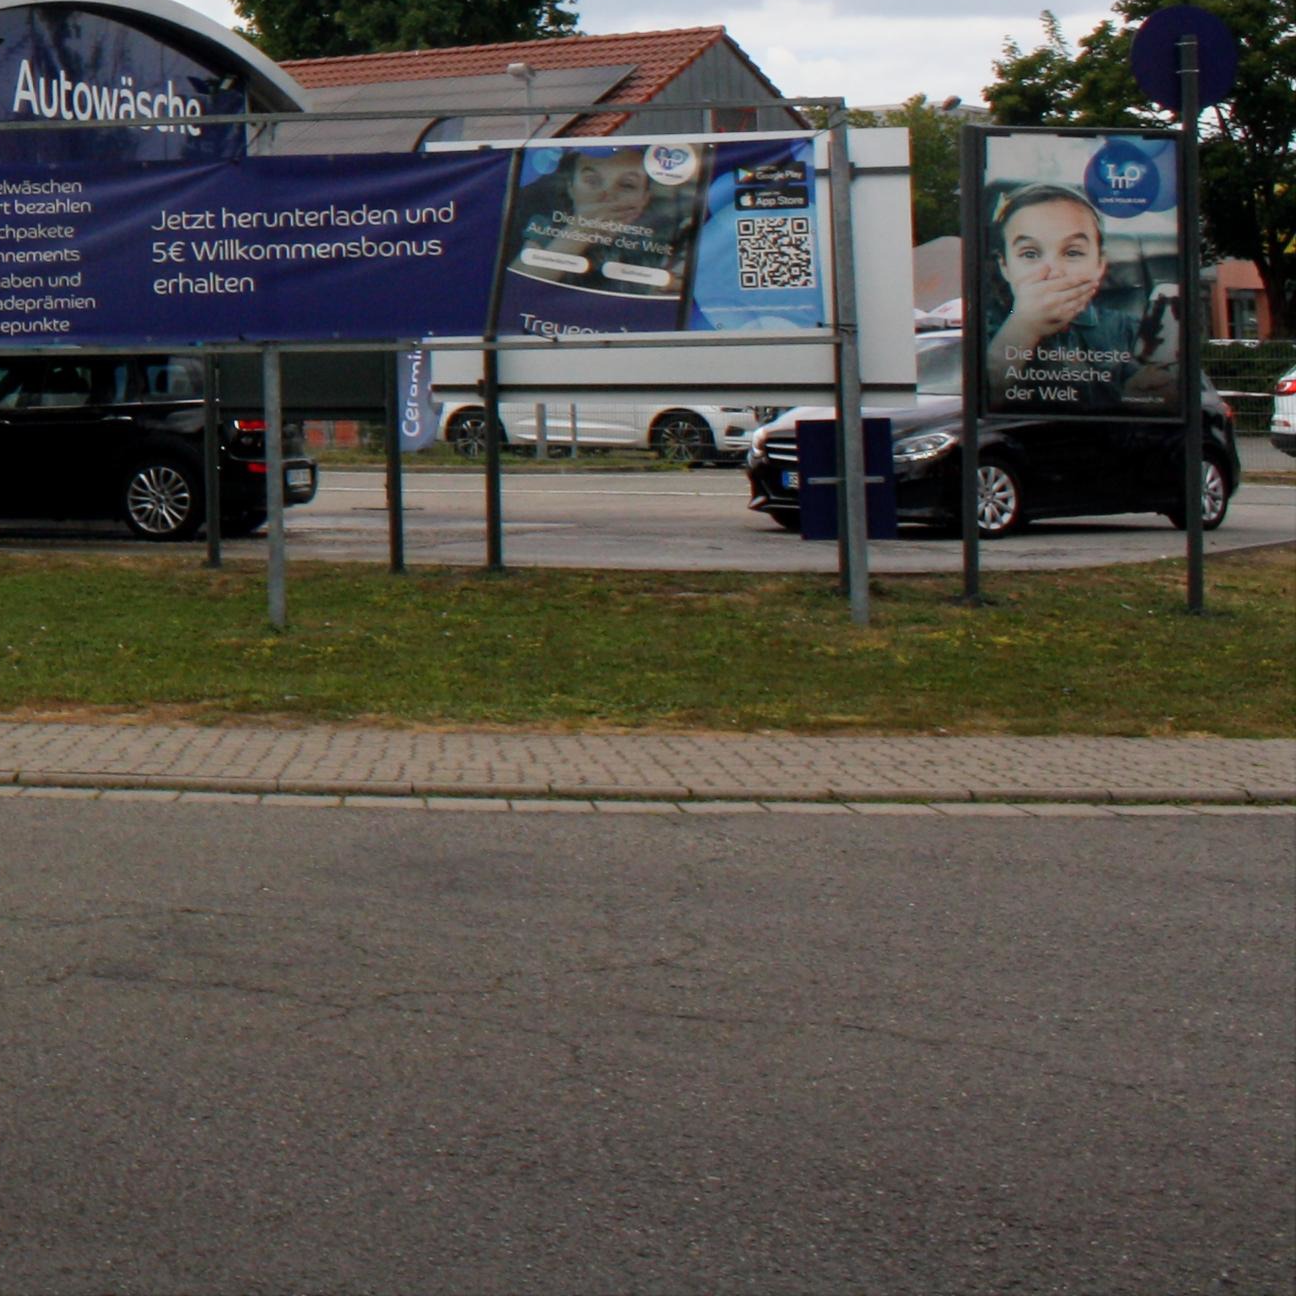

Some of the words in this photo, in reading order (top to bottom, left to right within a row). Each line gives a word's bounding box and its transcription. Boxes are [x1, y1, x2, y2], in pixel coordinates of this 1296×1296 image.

[13, 59, 201, 136] Autowäsche
[15, 198, 91, 214] bezahlen
[152, 208, 215, 231] Jetzt
[222, 205, 397, 228] herunterladen
[405, 201, 454, 223] und
[552, 210, 575, 225] Die
[578, 214, 654, 237] beliebteste
[152, 241, 185, 262] 5€
[191, 236, 442, 261] Willkommensbonus
[527, 222, 612, 246] Autowäsche
[615, 236, 640, 251] der
[641, 239, 674, 255] Welt
[48, 272, 81, 287] und
[153, 272, 255, 294] erhalten
[1005, 346, 1033, 361] Die
[1037, 346, 1131, 363] beliebteste
[1005, 366, 1111, 382] Autowäsche
[1005, 386, 1034, 400] der
[1038, 386, 1079, 401] Welt
